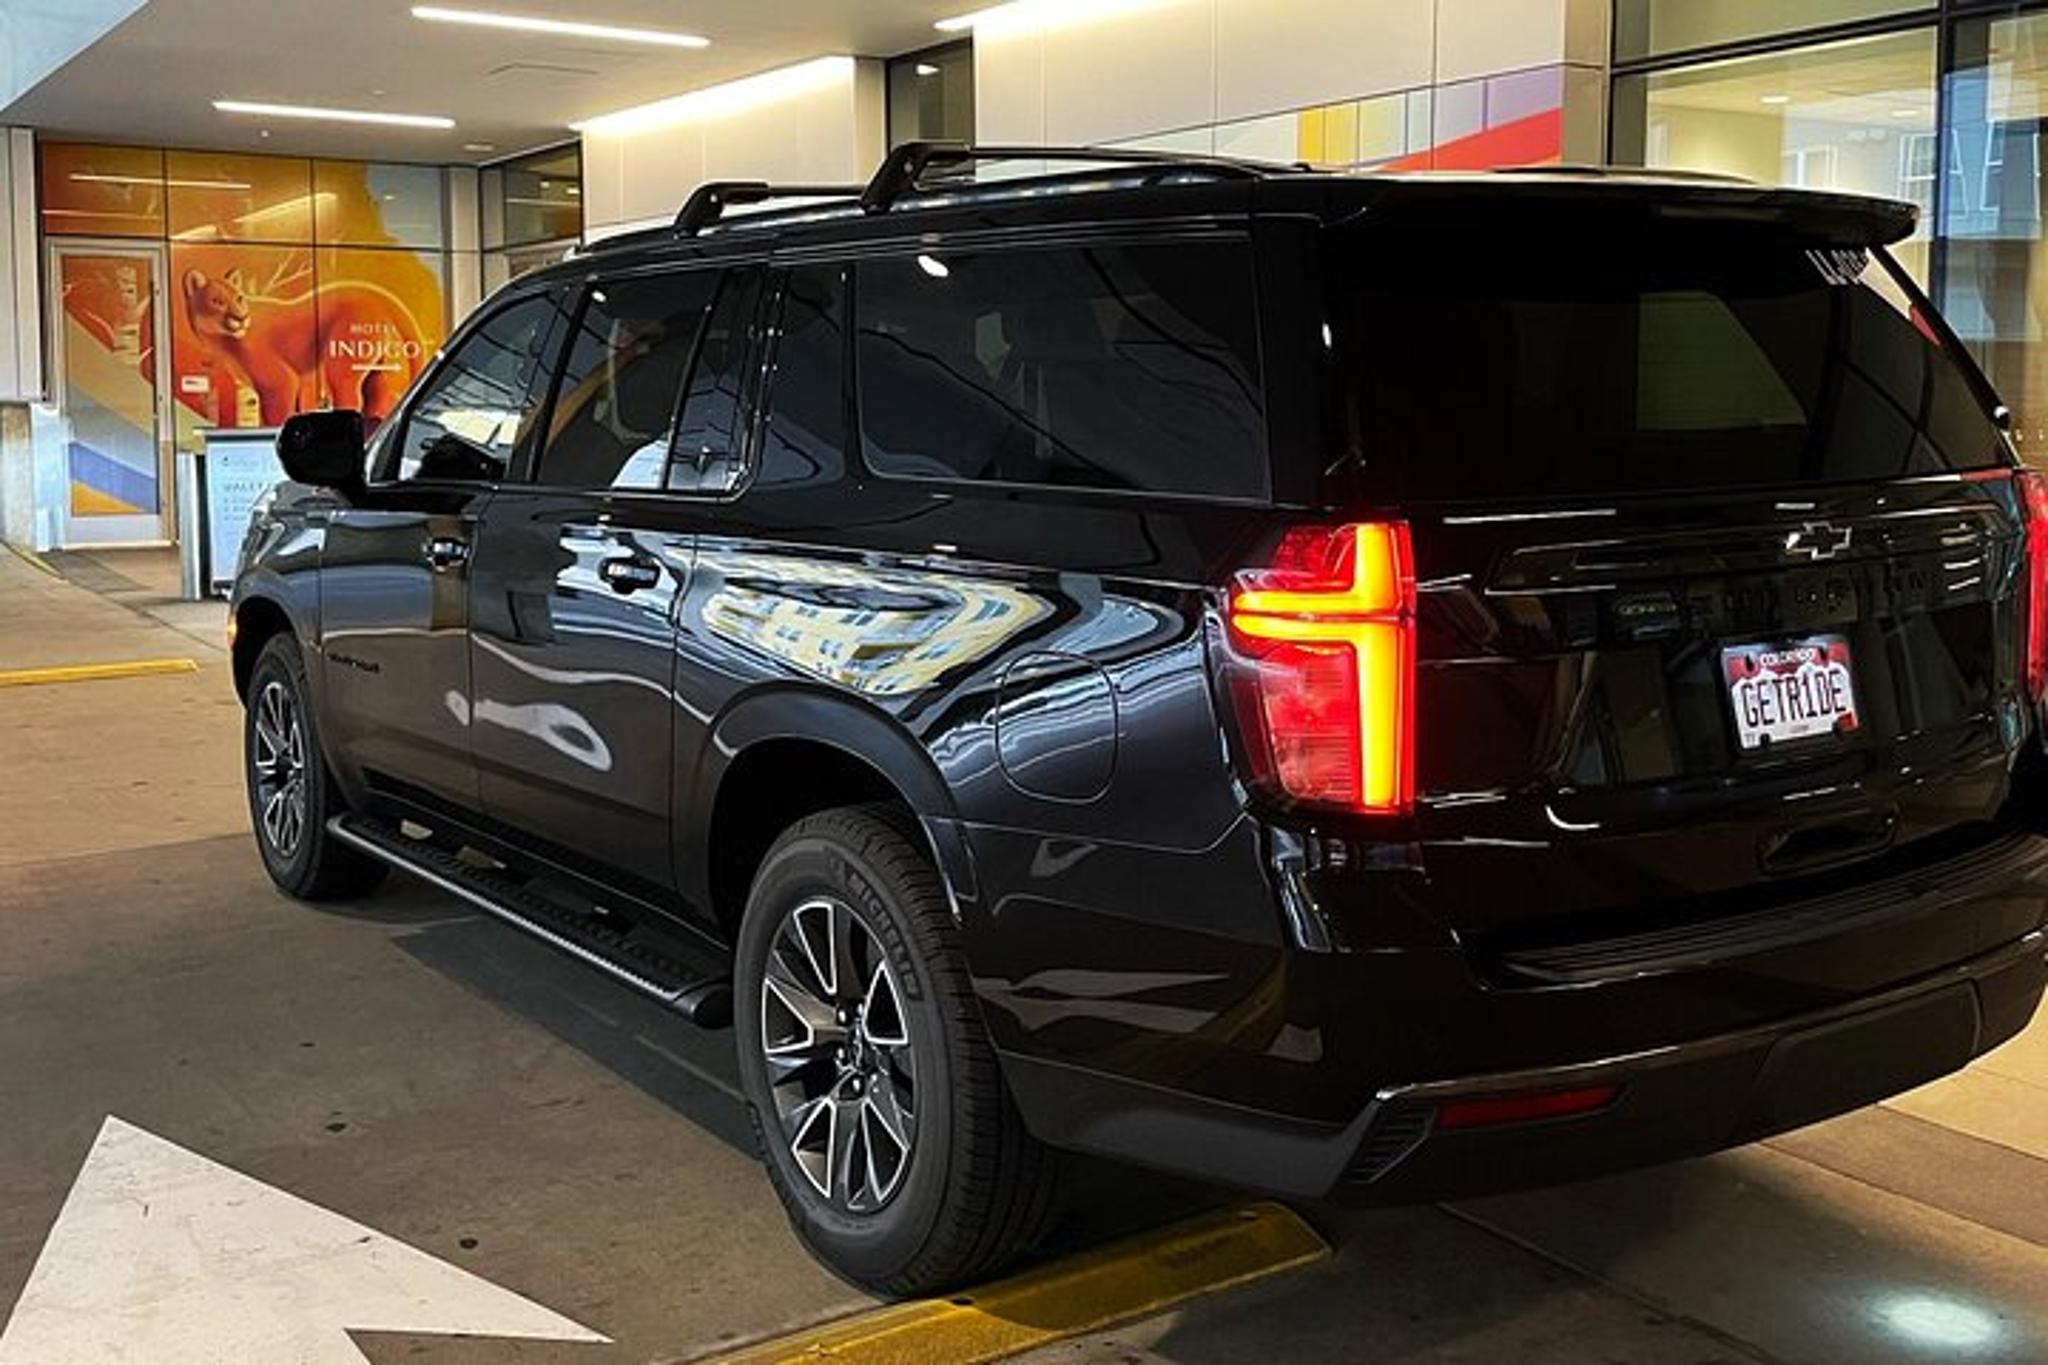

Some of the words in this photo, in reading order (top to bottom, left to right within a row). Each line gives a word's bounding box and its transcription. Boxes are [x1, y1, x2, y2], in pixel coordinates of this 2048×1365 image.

[350, 323, 397, 335] HOTEL
[329, 339, 421, 359] INDIGO
[1741, 670, 1846, 727] GETR1DE
